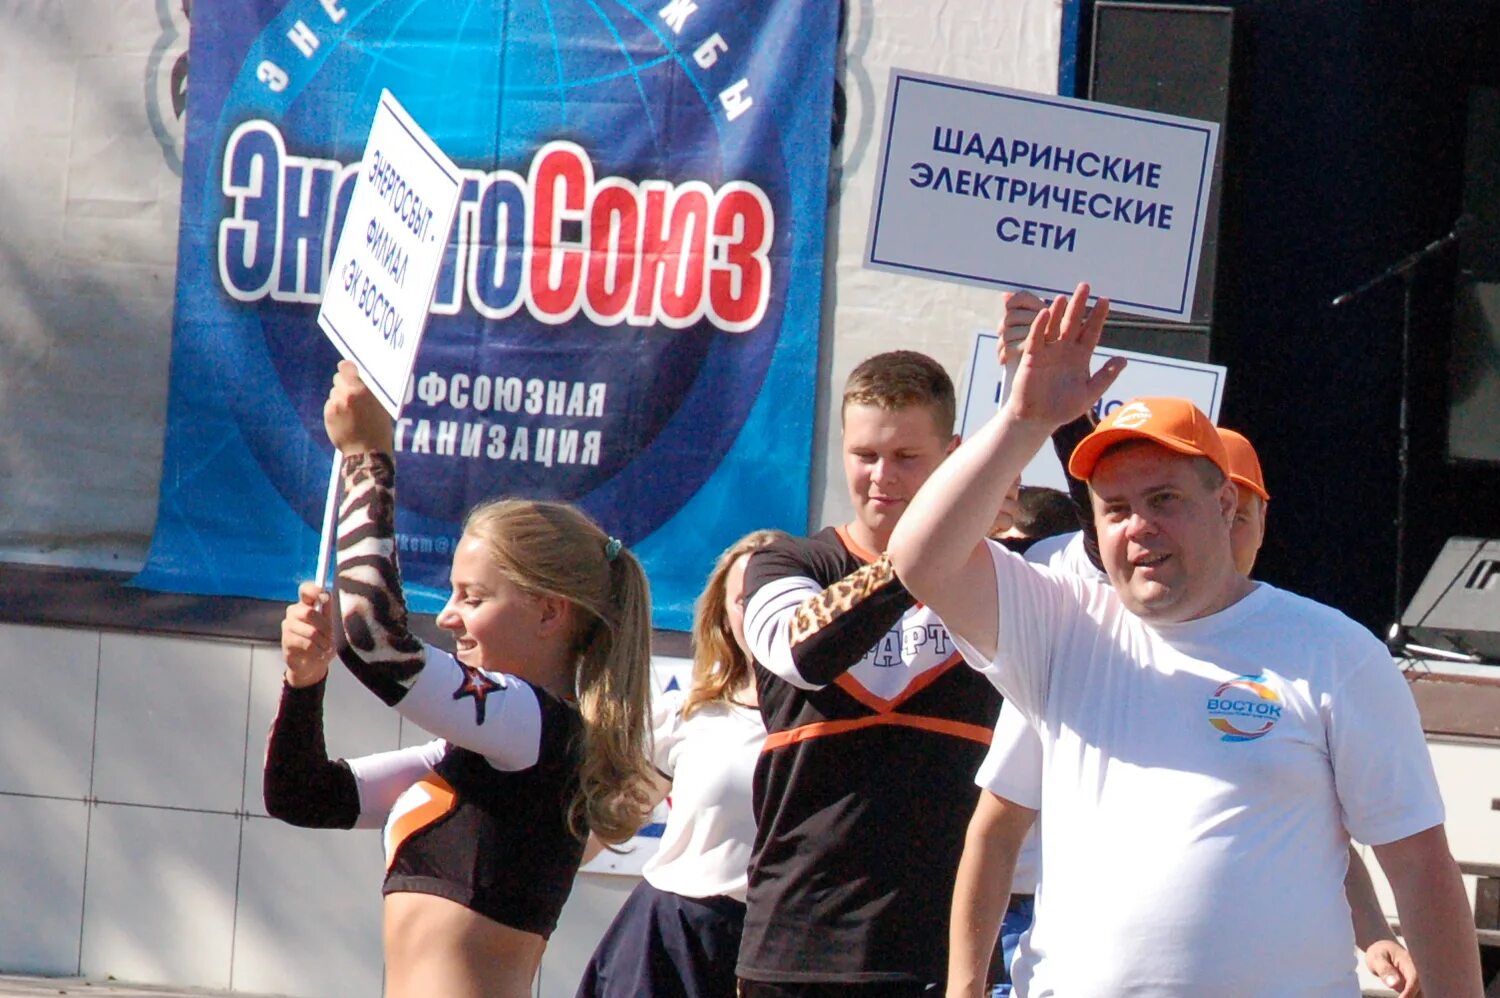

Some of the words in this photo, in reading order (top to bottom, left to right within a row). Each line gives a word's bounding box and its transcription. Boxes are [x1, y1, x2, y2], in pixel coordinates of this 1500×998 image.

[932, 125, 1162, 190] ШАДРИНСКИЕ
[369, 149, 433, 243] ЭНЕРГОСБЫТ
[908, 162, 1174, 230] ЭЛЕКТРИЧЕСКИЕ
[366, 216, 409, 289] ФИЛИАЛ
[996, 216, 1077, 253] СЕТИ
[863, 624, 950, 667] АРТ
[1206, 699, 1282, 718] ВОСТОК
